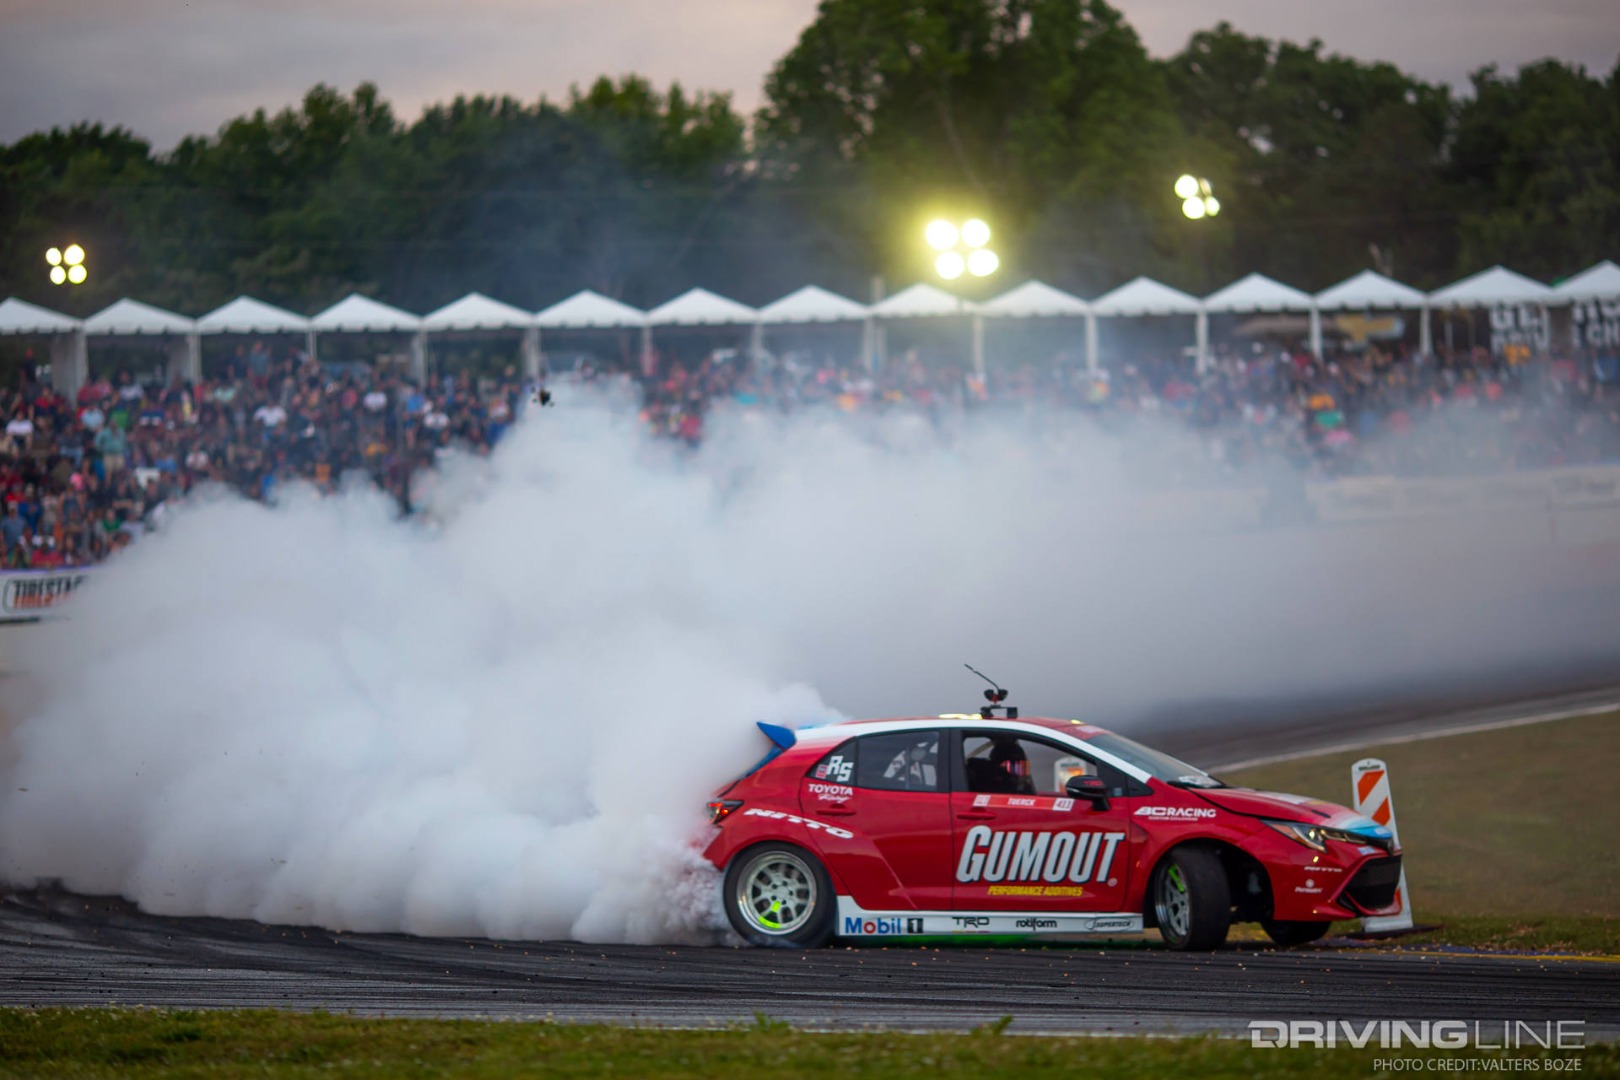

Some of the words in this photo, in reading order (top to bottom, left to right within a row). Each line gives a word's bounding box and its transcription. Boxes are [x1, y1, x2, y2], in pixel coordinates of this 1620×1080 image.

[808, 783, 853, 796] TOYOTA
[743, 808, 854, 839] NITTO
[955, 825, 1126, 883] GUMOUT
[987, 886, 1044, 896] PERFORMANCE
[1044, 886, 1083, 897] ADDITIVES
[845, 917, 902, 934] Mobil
[952, 917, 990, 928] TRD
